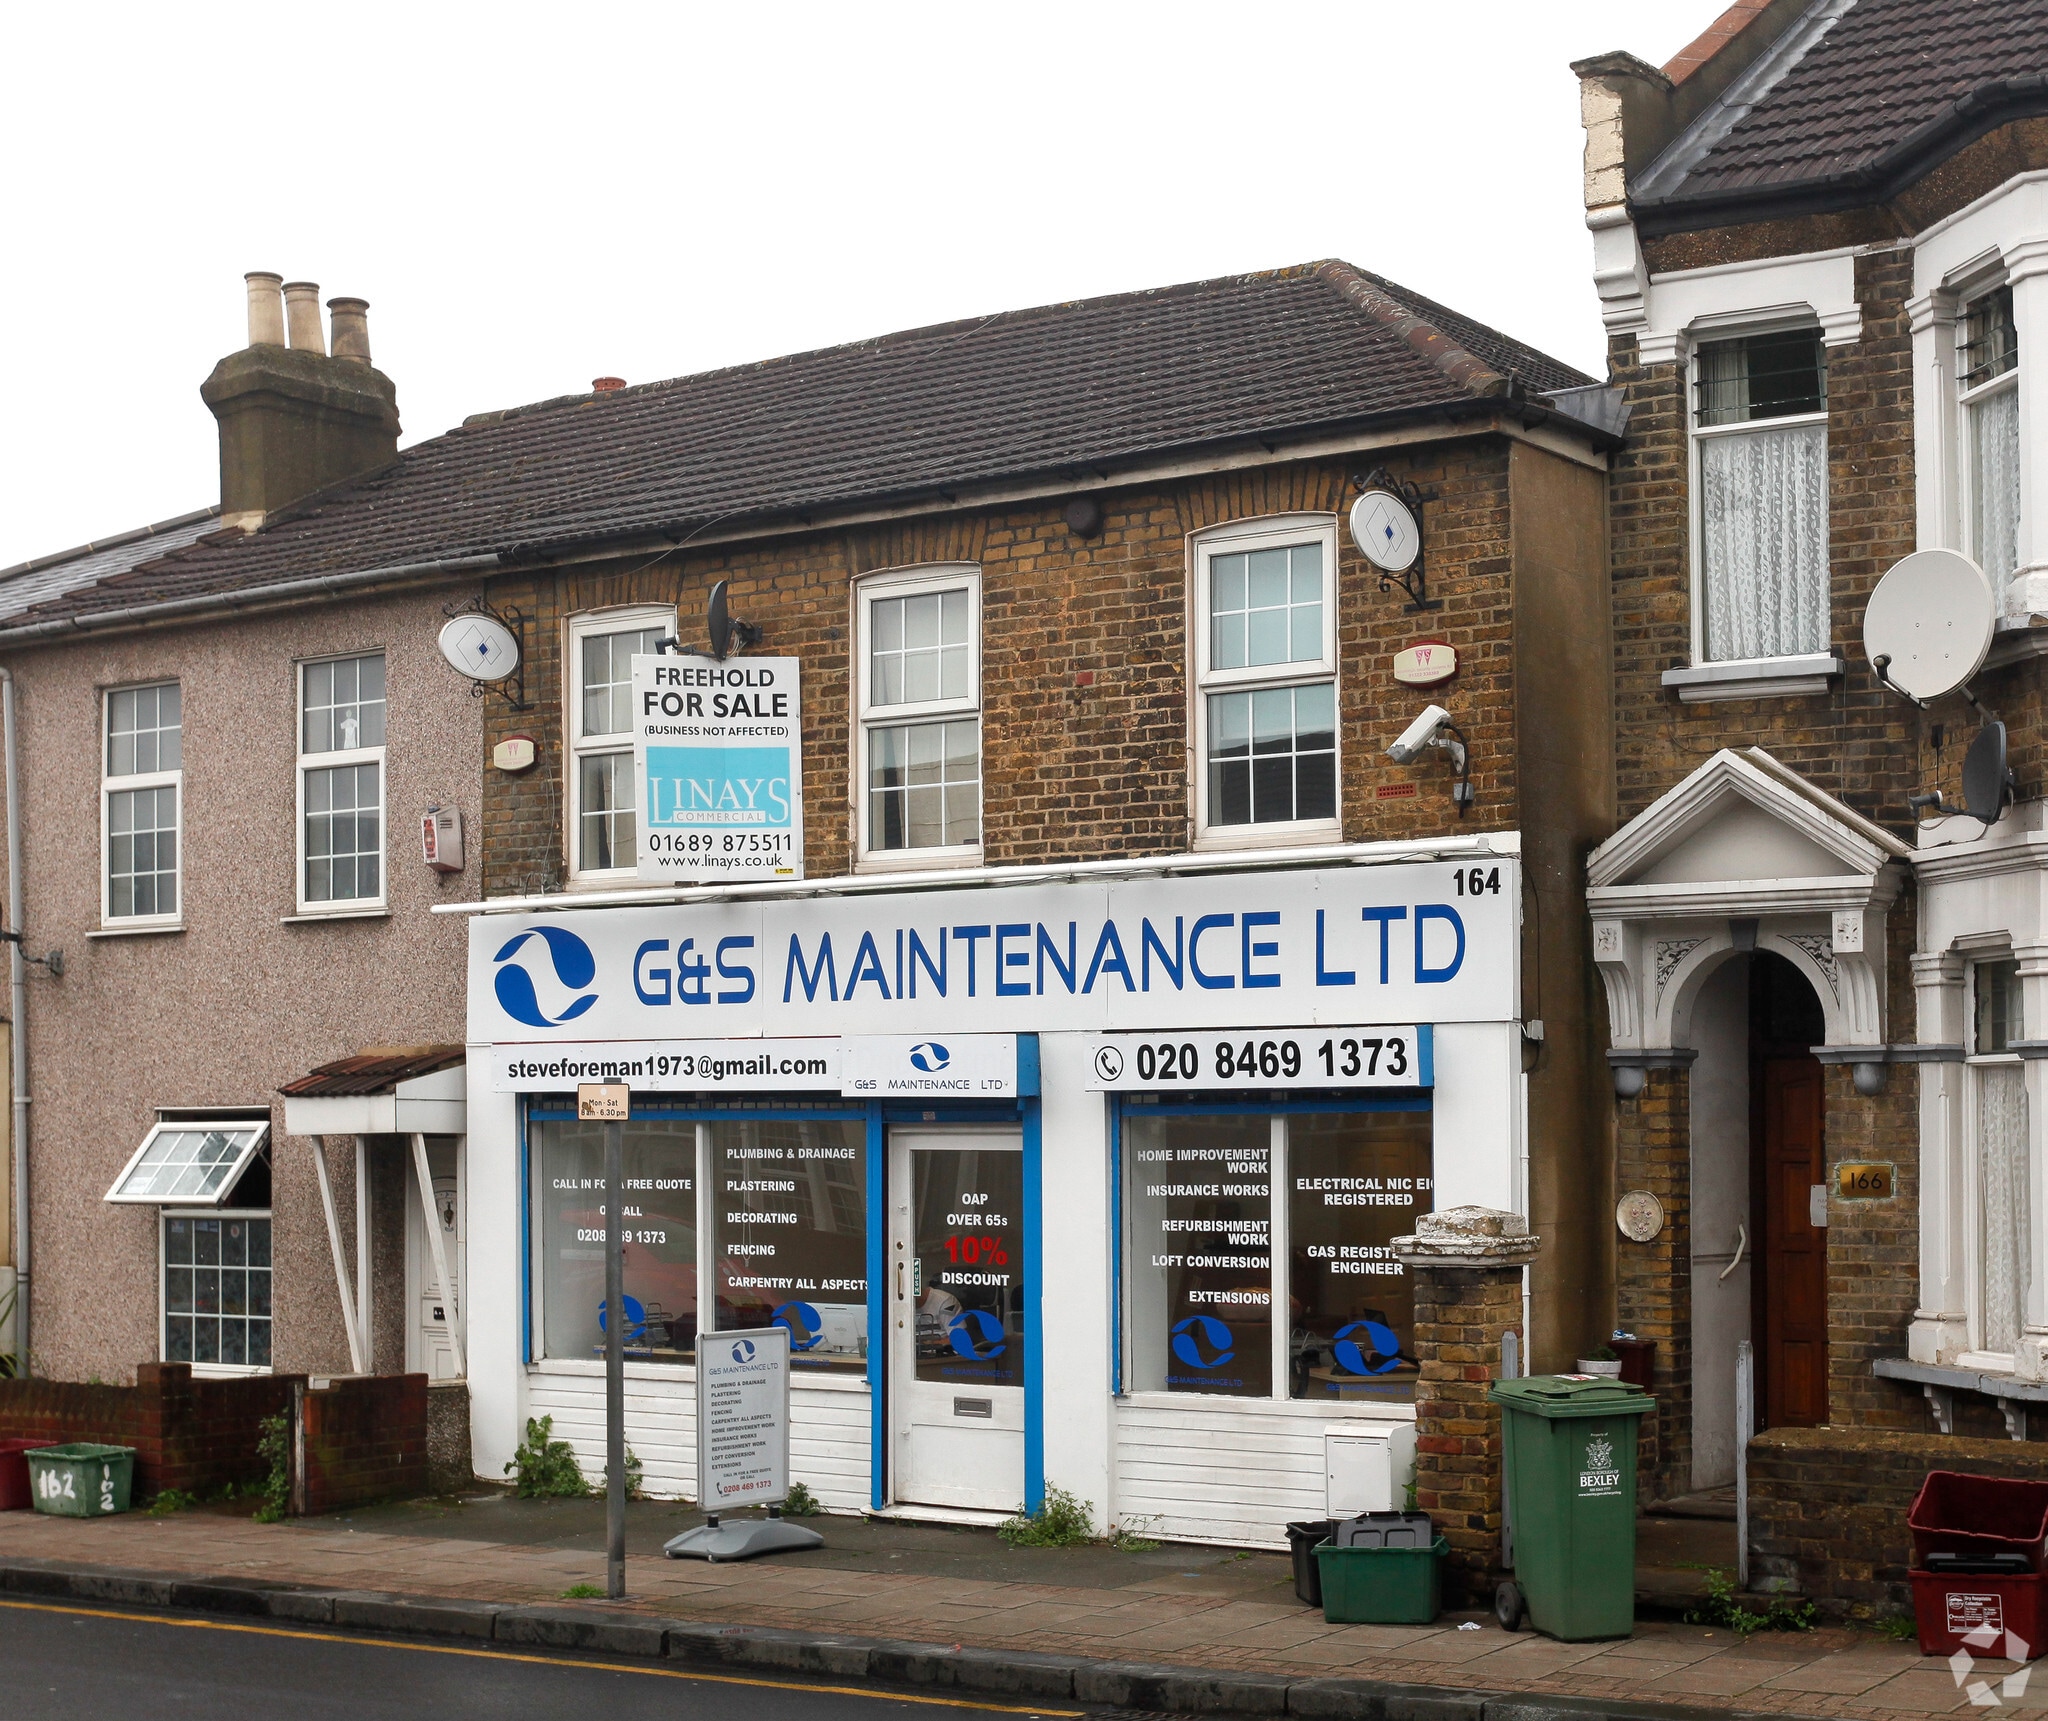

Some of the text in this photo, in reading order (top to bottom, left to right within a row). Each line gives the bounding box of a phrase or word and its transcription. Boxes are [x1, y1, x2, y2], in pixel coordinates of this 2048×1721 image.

[655, 667, 775, 687] FREEHOLD
[644, 691, 788, 718] FOR SALE
[644, 725, 789, 738] (BUSINESS NOT AFFECTED)
[650, 777, 788, 823] LINAYS
[676, 812, 762, 821] COMMERCIAL
[650, 834, 791, 851] 01689 875511
[658, 853, 783, 870] www.linays.co.uk
[1453, 867, 1501, 896] 164
[633, 904, 1466, 1006] G&S MAINTENANCE LTD
[1137, 1037, 1408, 1081] 020 8469 1373
[508, 1054, 827, 1081] steveforeman1973@gmail.com
[855, 1080, 1003, 1089] G&S MAINTENANCE LTD
[727, 1148, 855, 1159] PLUMBING & DRAINAGE
[1138, 1149, 1268, 1161] HOME IMPROVEMENT
[1227, 1162, 1268, 1174] WORK
[553, 1179, 606, 1189] CALL IN FO
[627, 1179, 652, 1189] FREE
[656, 1180, 691, 1190] QUOTE
[727, 1181, 795, 1192] PLASTERING
[1297, 1178, 1433, 1190] ELECTRICAL NIC EI
[1851, 1172, 1883, 1190] 166
[1147, 1185, 1269, 1196] INSURANCE WORKS
[962, 1193, 988, 1205] OAP
[1324, 1194, 1413, 1206] REGISTERED
[622, 1206, 642, 1216] ALL
[727, 1213, 797, 1224] DECORATING
[947, 1214, 1008, 1226] OVER 65s
[1162, 1220, 1269, 1232] REFURBISHMENT
[577, 1229, 606, 1241] 0208
[636, 1231, 666, 1243] 1373
[1228, 1233, 1269, 1245] WORK
[727, 1245, 775, 1256] FENCING
[944, 1236, 1008, 1265] 10%
[1307, 1246, 1336, 1258] GAS
[1152, 1255, 1269, 1269] LOFT CONVERSION
[1331, 1262, 1404, 1275] ENGINEER
[728, 1276, 793, 1289] CARPENTRY
[796, 1278, 817, 1289] ALL
[942, 1272, 1010, 1286] DISCOUNT
[1189, 1291, 1270, 1304] EXTENSIONS
[723, 1363, 766, 1374] MAINTENANCE
[767, 1362, 778, 1370] LTD
[711, 1390, 741, 1398] PLASTERING
[711, 1399, 742, 1407] DECORATING
[711, 1417, 740, 1425] CARPENTRY
[726, 1424, 760, 1432] IMPROVEMENT
[711, 1435, 739, 1443] INSURANCE
[711, 1442, 751, 1452] REFURBISHMENT
[725, 1451, 755, 1459] CONVERSION
[723, 1480, 772, 1493] 0208 469 1373
[1580, 1474, 1619, 1487] BEXLEY
